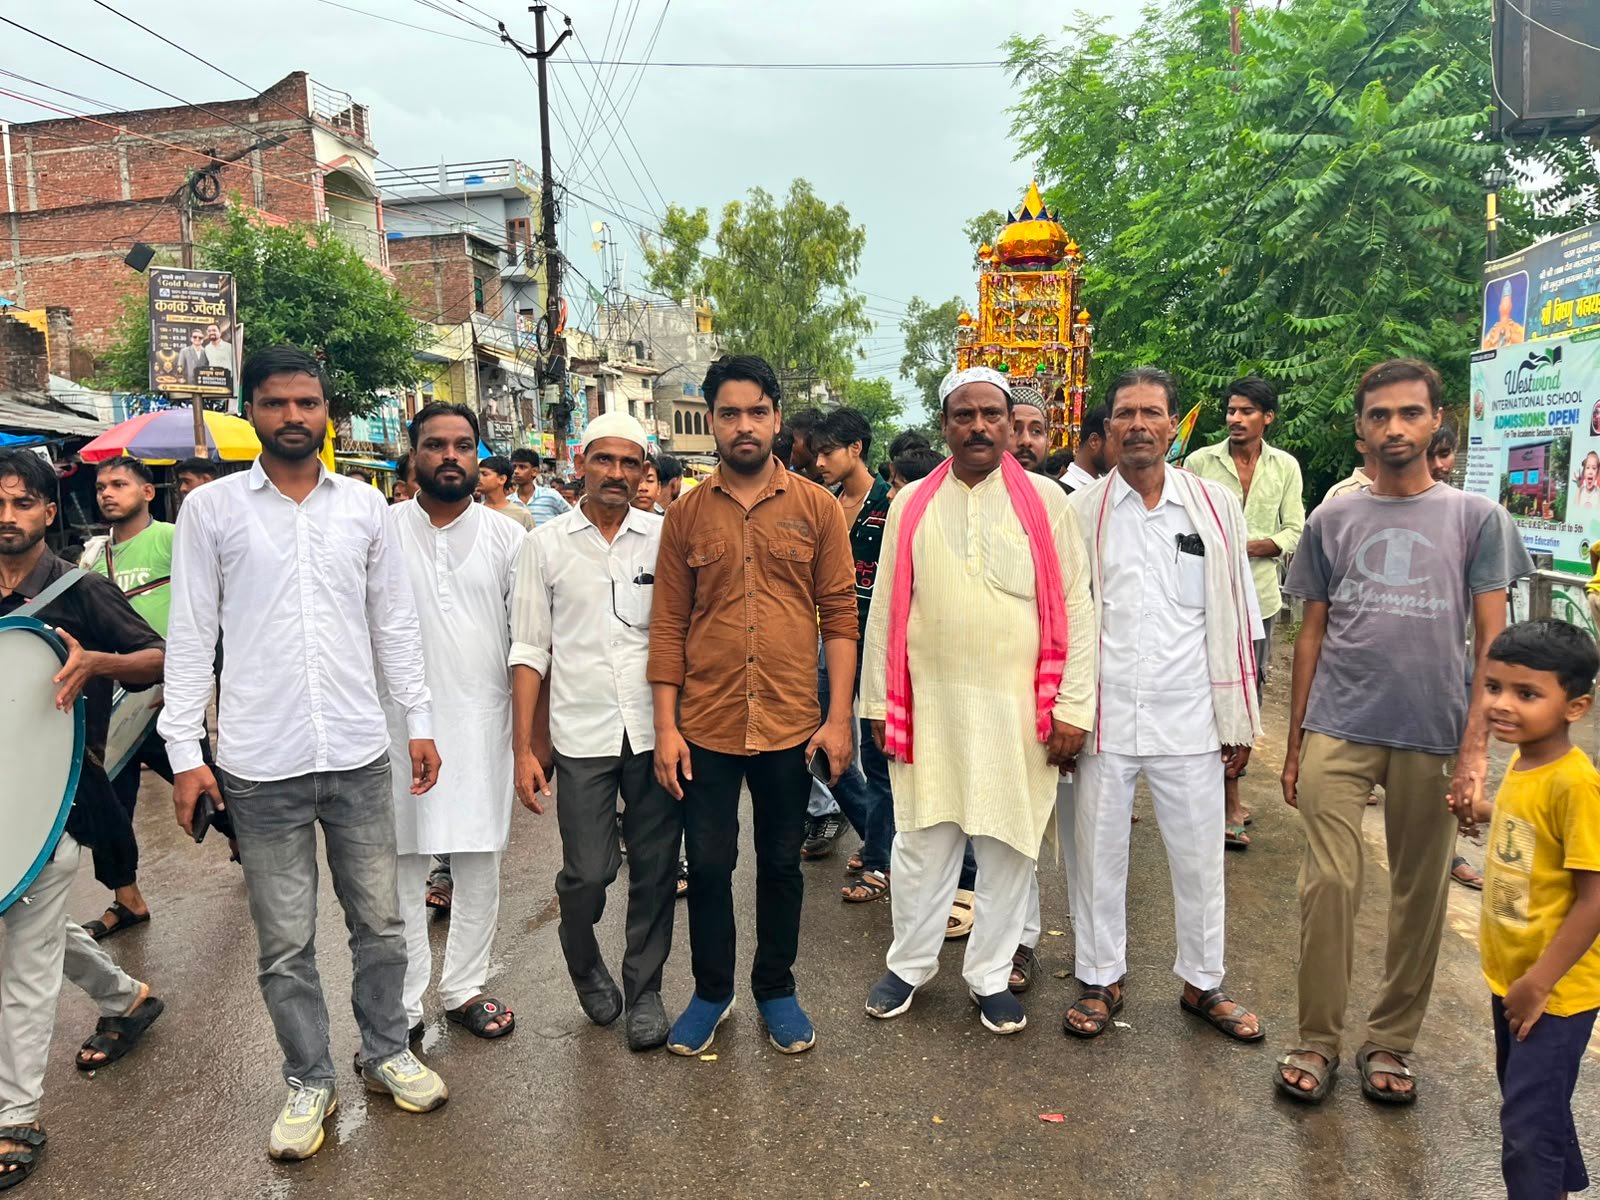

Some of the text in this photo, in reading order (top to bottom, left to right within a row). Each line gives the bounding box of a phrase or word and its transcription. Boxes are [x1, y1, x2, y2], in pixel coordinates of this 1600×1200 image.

[162, 279, 181, 287] Gold
[183, 280, 201, 288] Rate
[154, 299, 189, 313] कनक
[1504, 369, 1561, 395] Westwind
[1491, 390, 1582, 411] INTERNATIONAL SCHOOL
[1493, 408, 1580, 430] ADMISSIONS OPEN!
[1517, 429, 1535, 437] Academic
[1536, 428, 1552, 437] Session
[1574, 523, 1584, 534] 5th
[1535, 535, 1560, 547] Education
